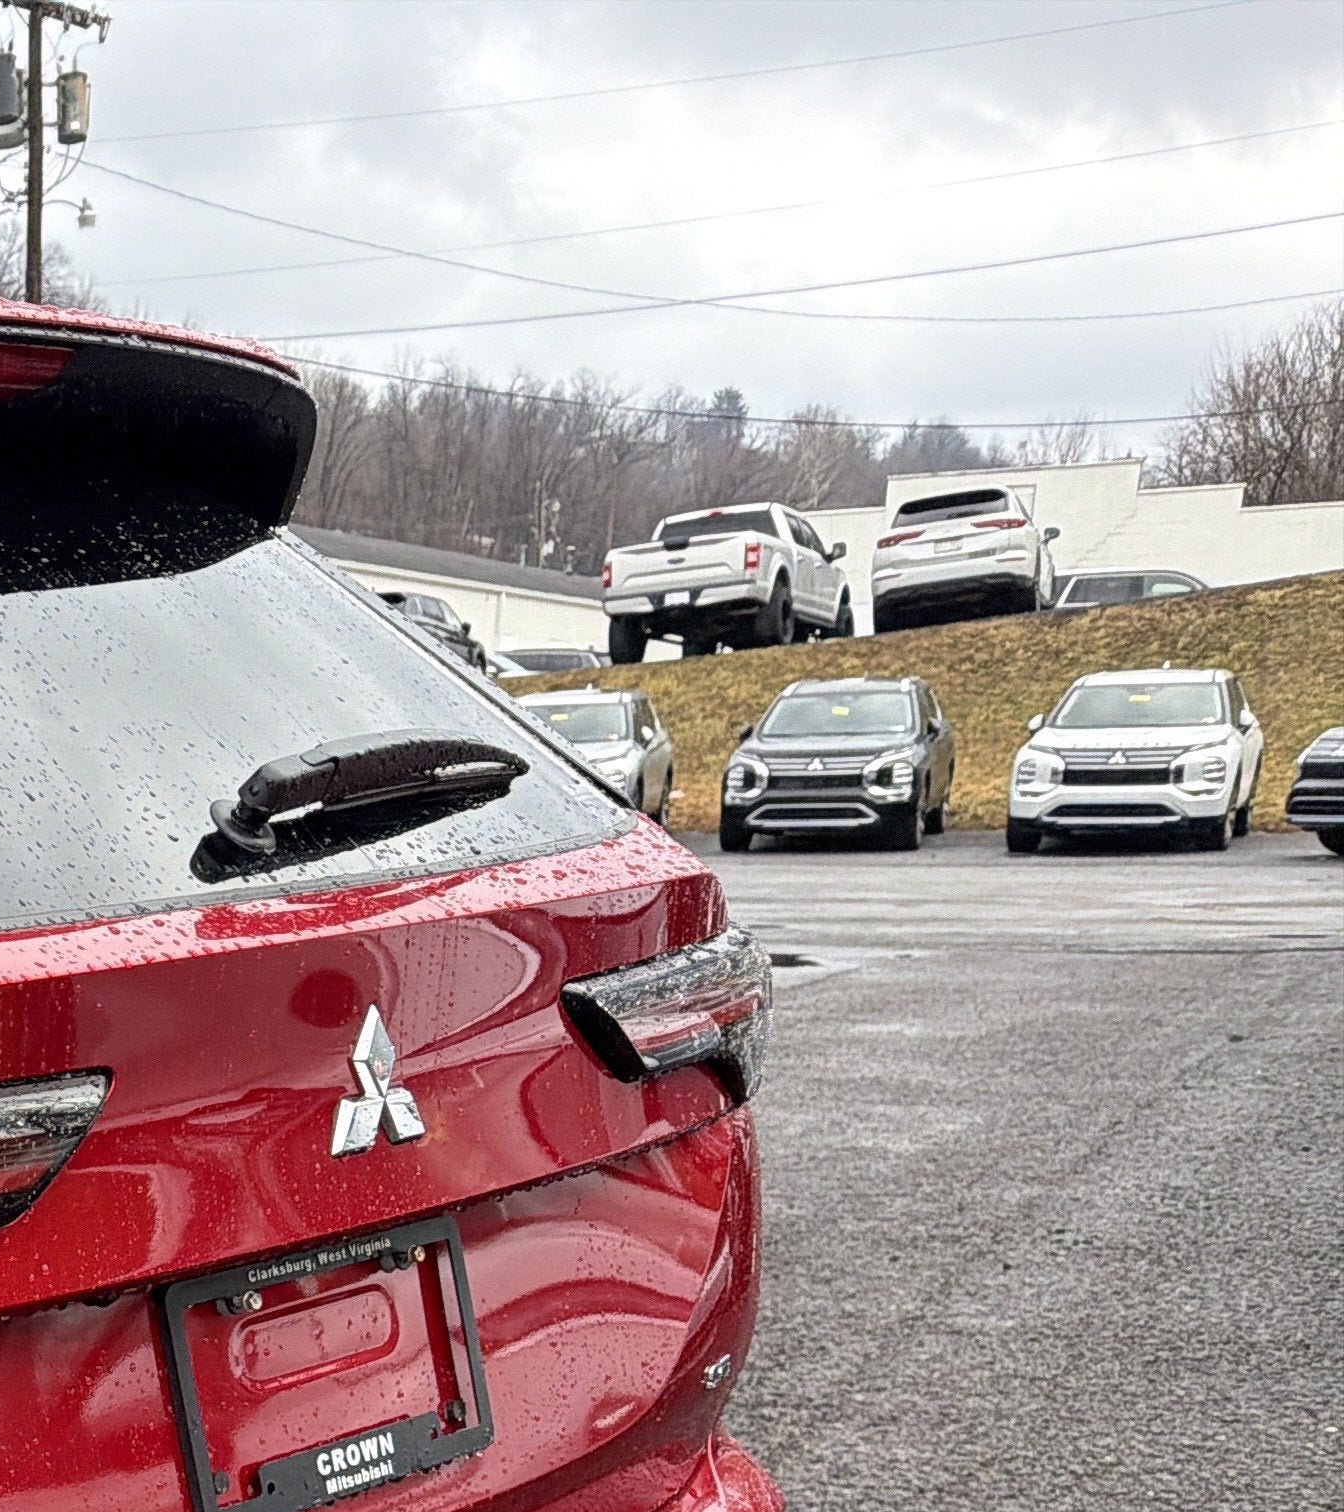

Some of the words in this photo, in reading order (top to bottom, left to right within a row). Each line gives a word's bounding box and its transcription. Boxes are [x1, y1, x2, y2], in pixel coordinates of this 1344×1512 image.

[248, 1259, 317, 1283] Clarksburg,
[317, 1248, 347, 1266] West
[349, 1237, 391, 1257] Virginia
[317, 1432, 395, 1476] CROWN
[326, 1459, 395, 1495] Mitsubishi
